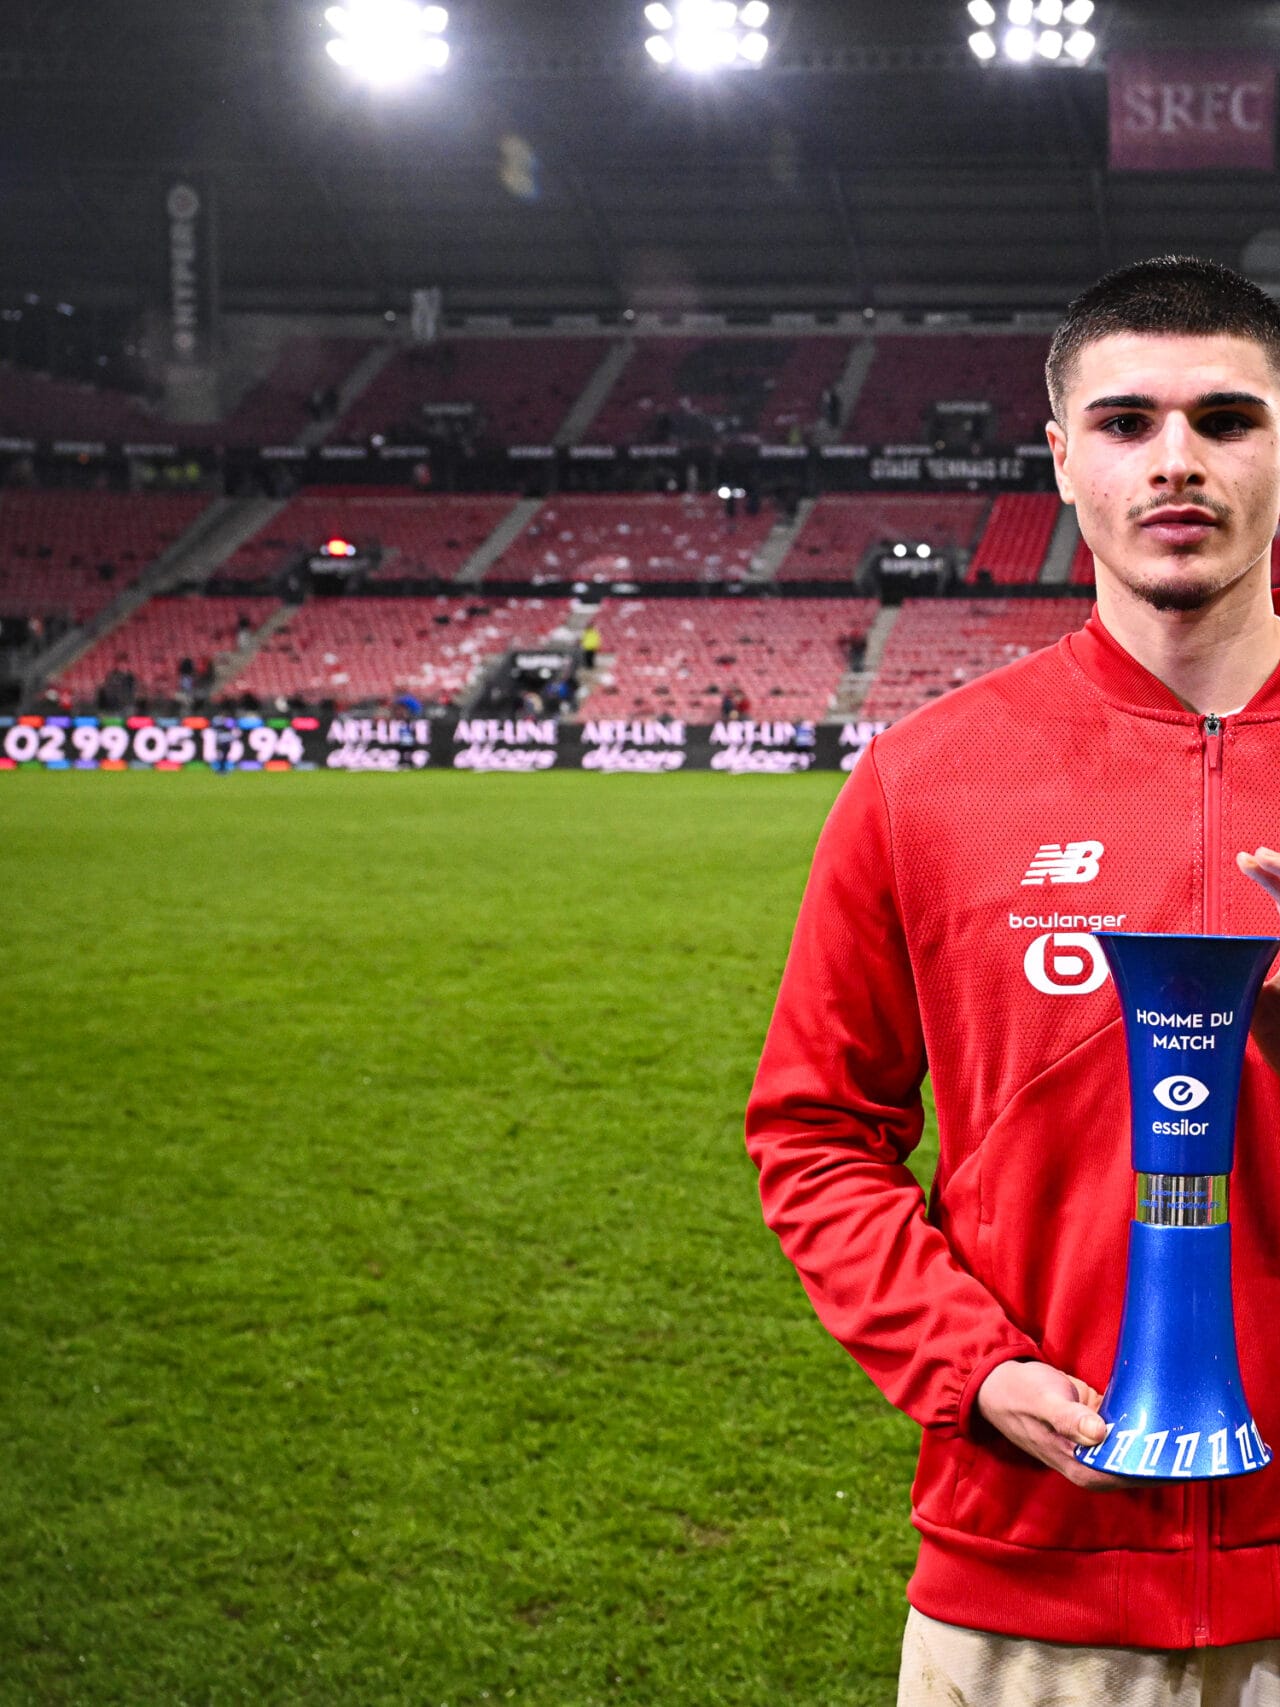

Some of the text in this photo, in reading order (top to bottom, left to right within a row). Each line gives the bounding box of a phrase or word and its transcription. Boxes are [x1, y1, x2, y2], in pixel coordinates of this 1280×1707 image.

[1123, 82, 1263, 132] SRFC
[453, 719, 557, 745] ART-LINE
[581, 719, 686, 746] ART-LINE
[4, 725, 65, 762] 02
[72, 725, 128, 762] 99
[133, 725, 195, 763] 05
[248, 726, 303, 763] 94
[1009, 912, 1126, 932] boulanger
[1136, 1009, 1234, 1028] HOMME DU
[1153, 1034, 1216, 1050] MATCH
[1152, 1119, 1209, 1135] essilor
